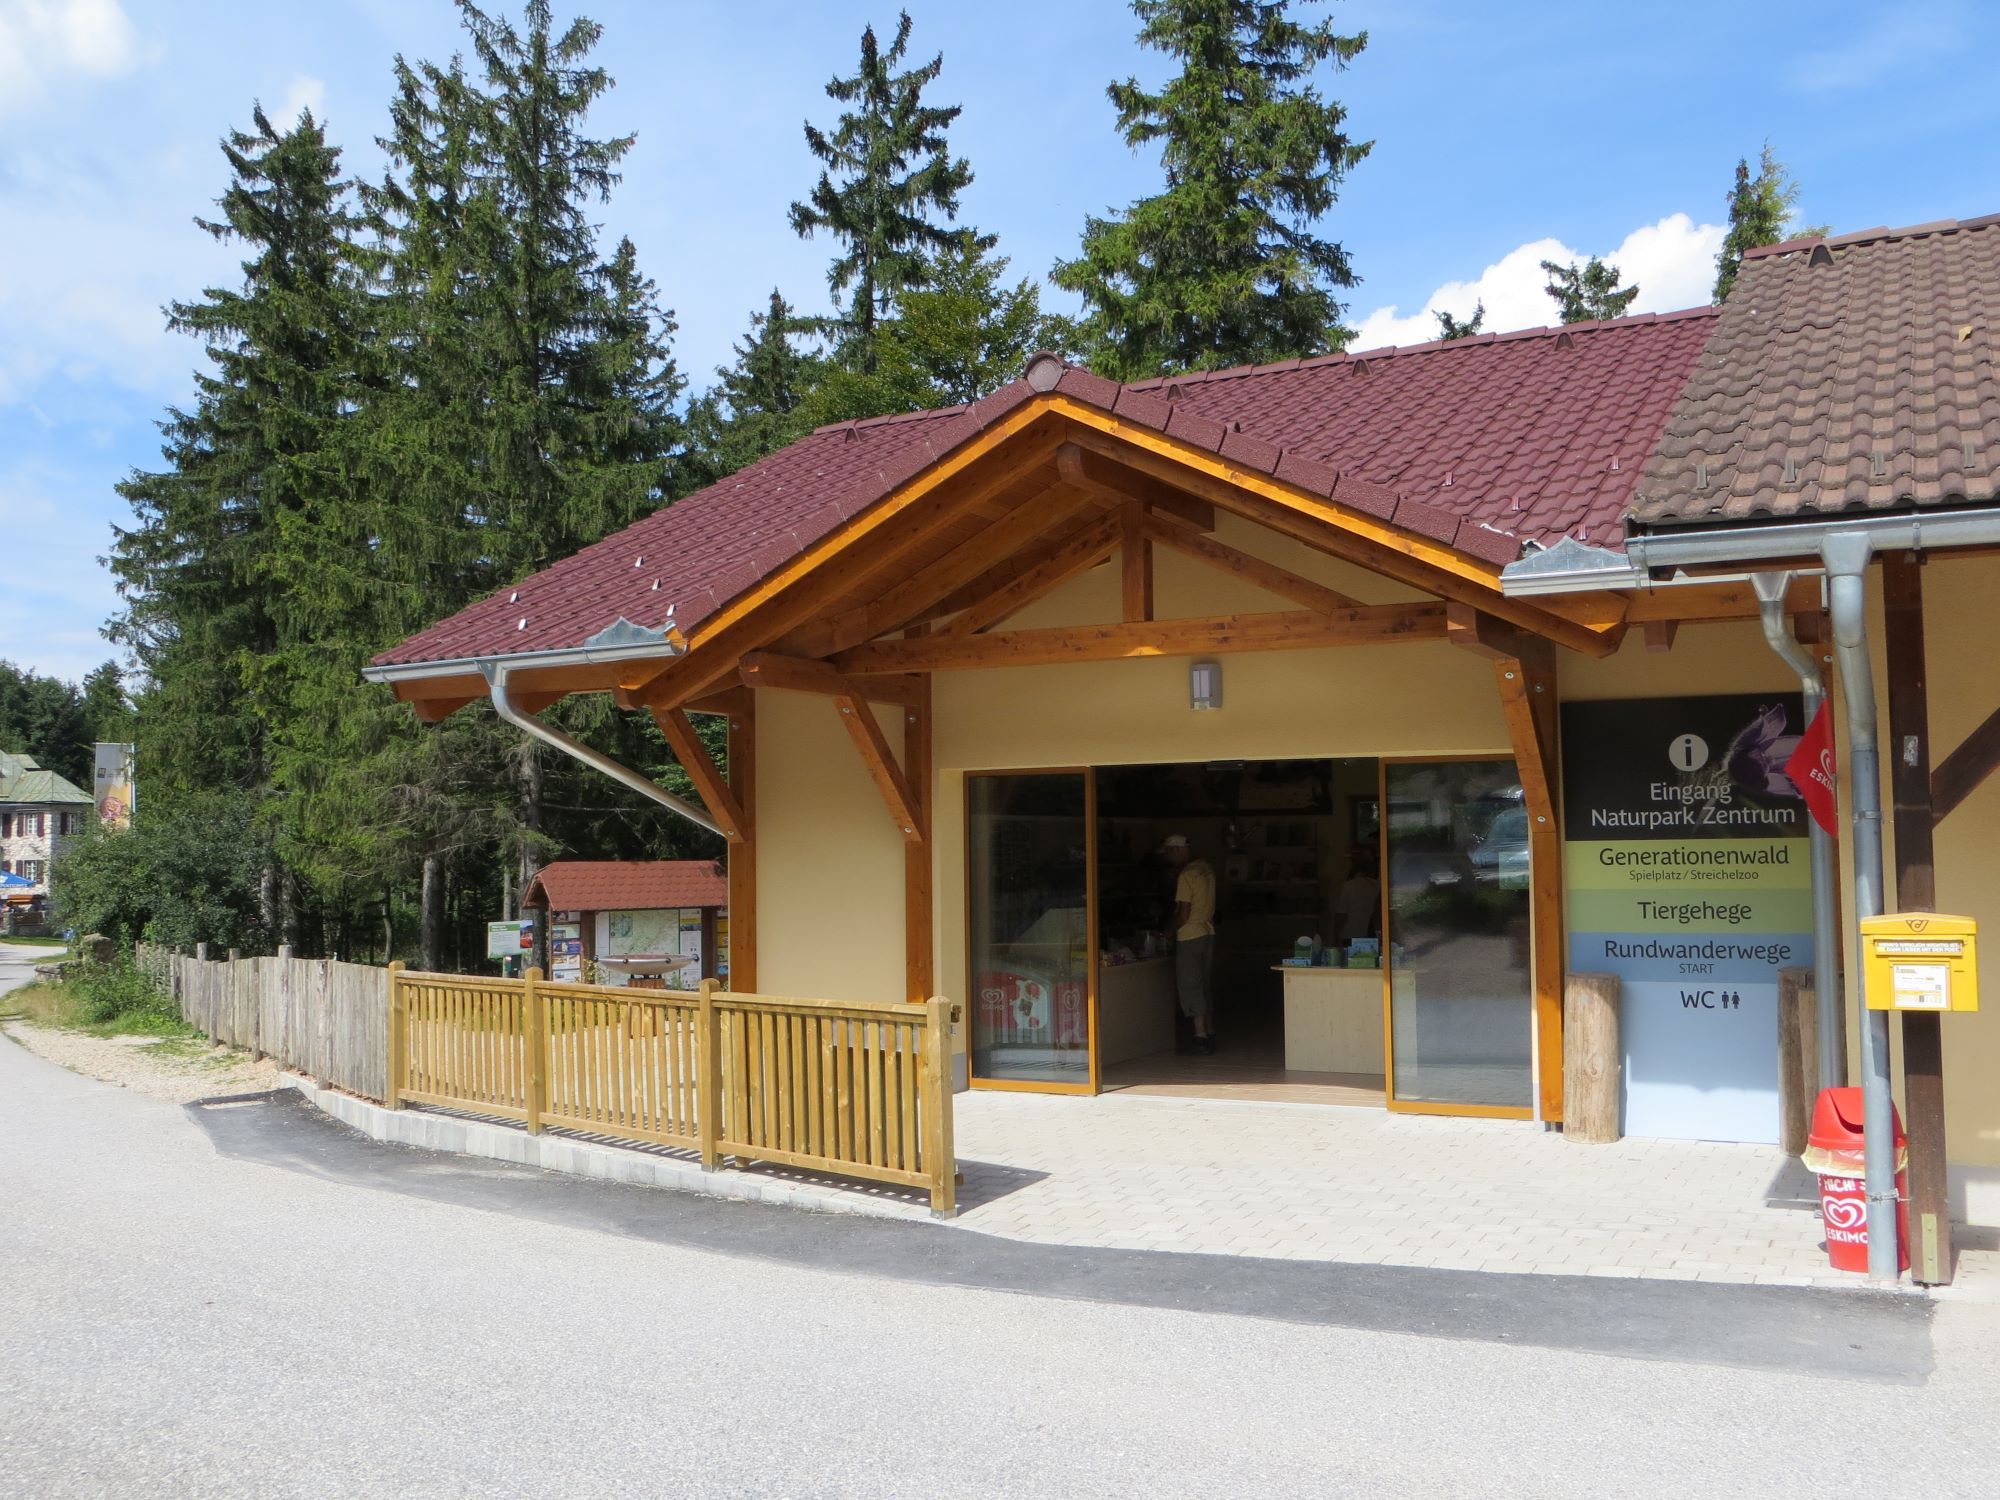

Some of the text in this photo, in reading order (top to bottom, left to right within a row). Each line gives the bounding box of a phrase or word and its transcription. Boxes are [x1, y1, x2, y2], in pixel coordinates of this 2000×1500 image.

[1650, 782, 1732, 804] Eingang
[1591, 806, 1796, 830] Naturpark Zentrum
[1599, 845, 1790, 866] Generationenwald
[1629, 869, 1681, 882] Spielplatz
[1690, 869, 1759, 880] Streichelzoo
[1637, 901, 1752, 924] Tiergehege
[1604, 939, 1791, 964] Rundwanderwege
[1679, 963, 1714, 974] START
[1680, 990, 1715, 1009] WC
